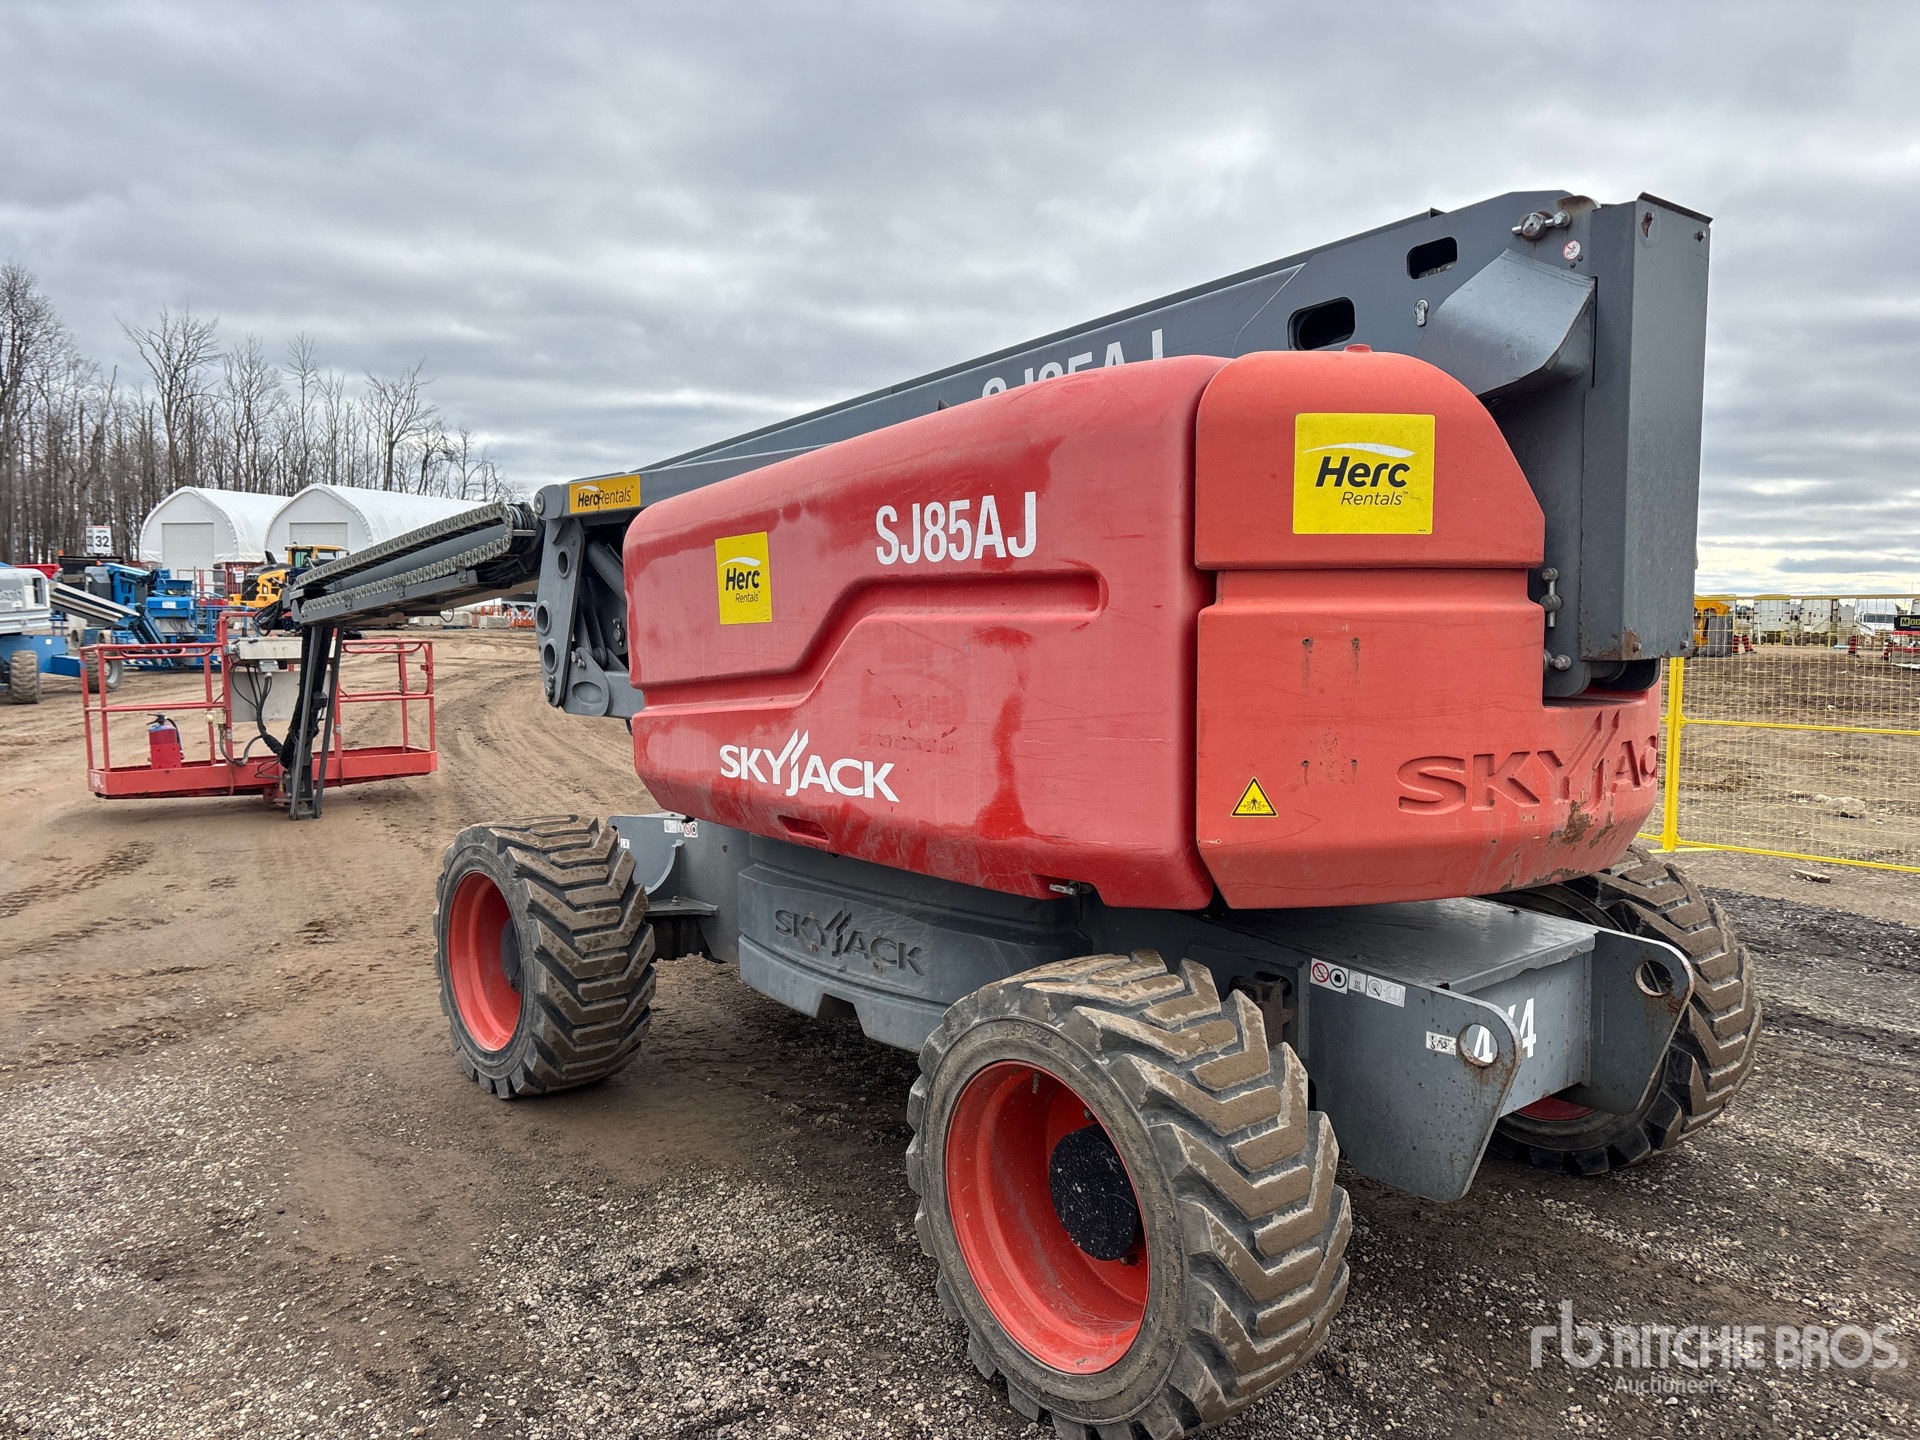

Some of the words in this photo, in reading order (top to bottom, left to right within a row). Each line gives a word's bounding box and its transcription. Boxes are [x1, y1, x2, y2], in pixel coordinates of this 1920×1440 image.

[1315, 456, 1411, 488] Herc
[95, 535, 110, 548] 32
[875, 492, 1038, 565] SJ85AJ
[725, 567, 761, 591] Herc
[719, 728, 901, 803] SKYJACK
[774, 909, 926, 976] SKYJACK
